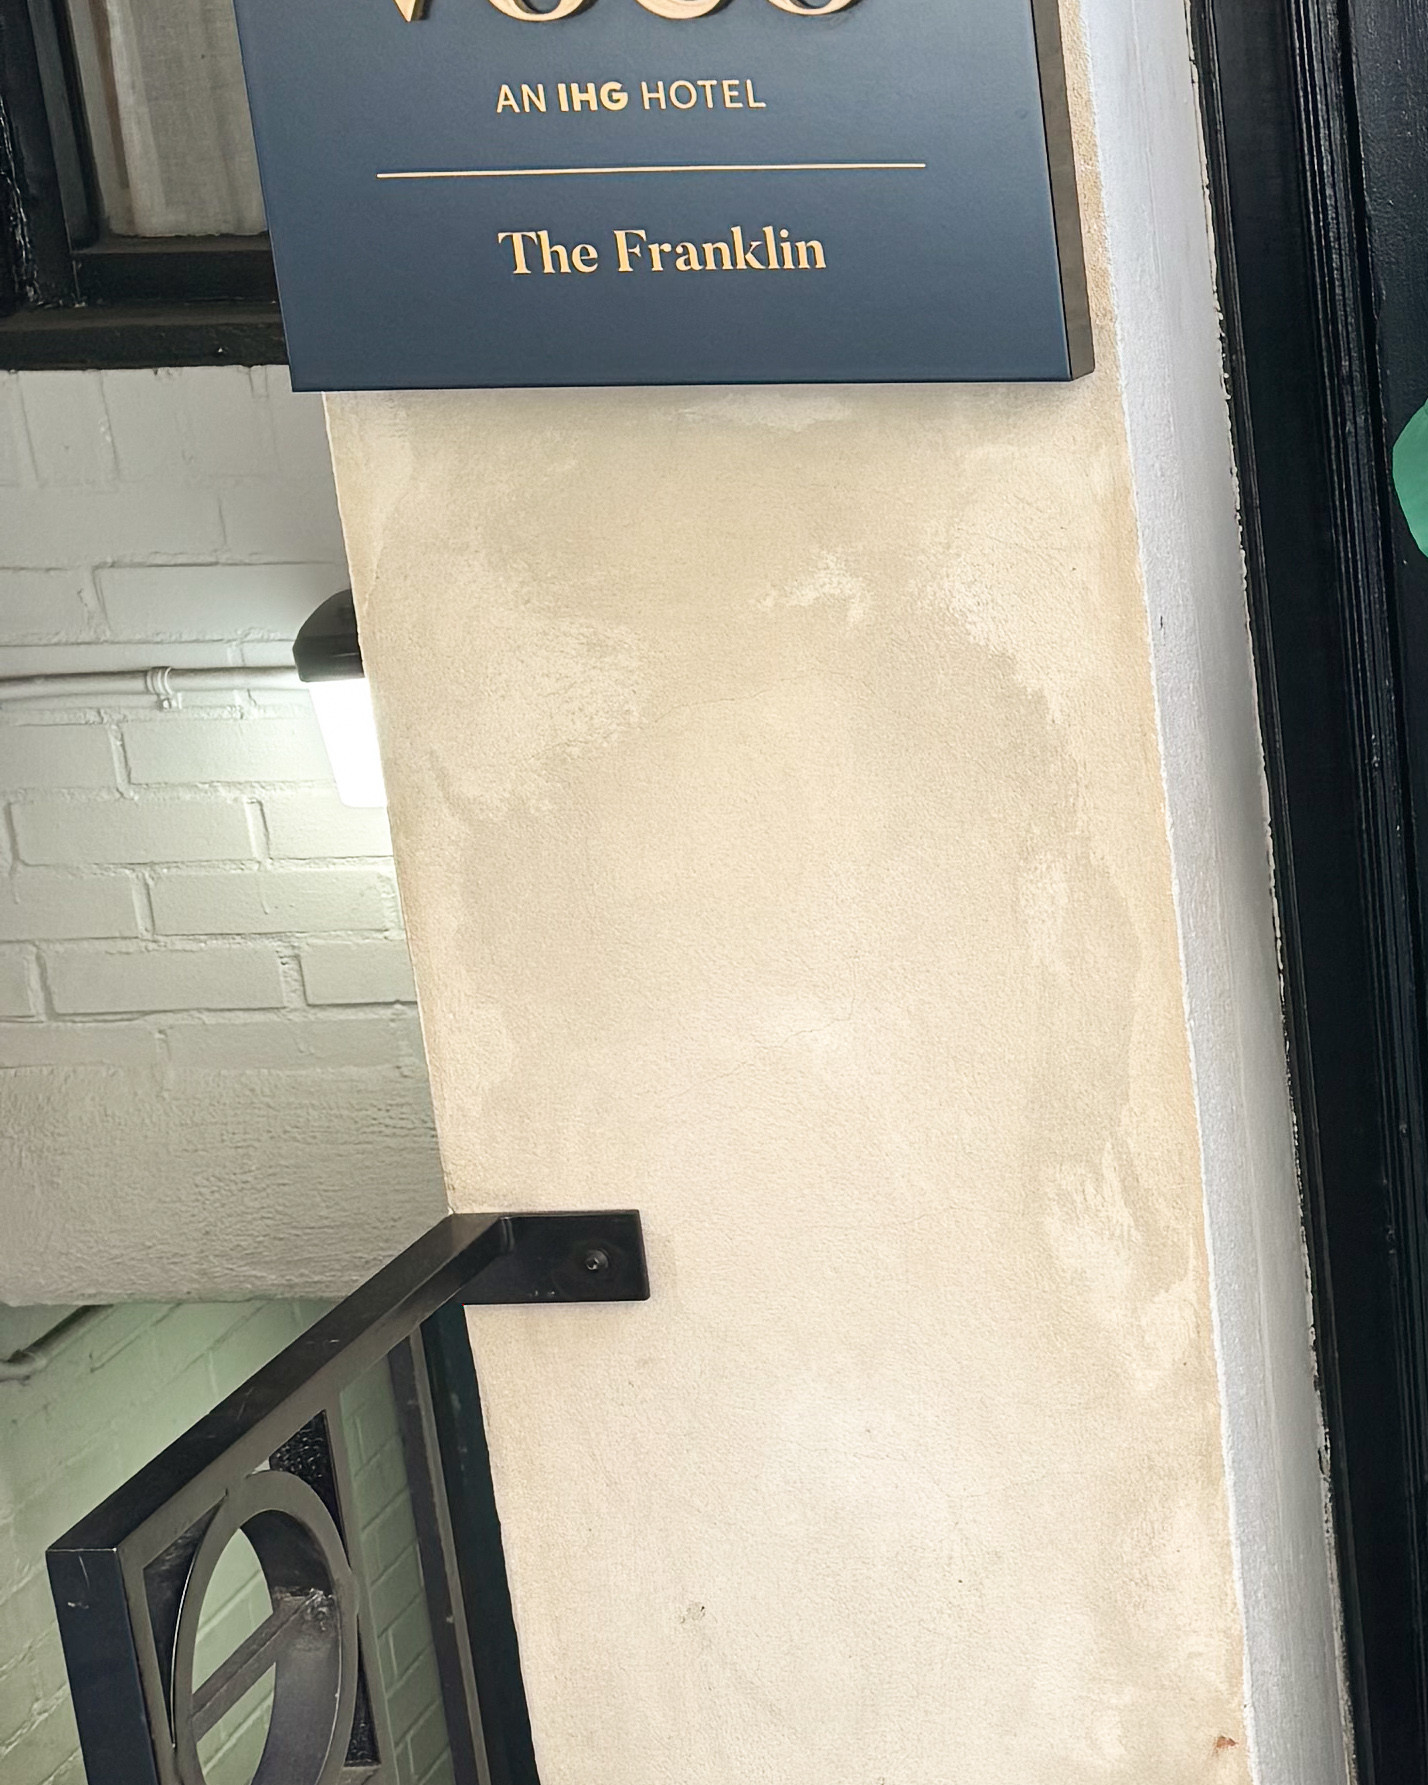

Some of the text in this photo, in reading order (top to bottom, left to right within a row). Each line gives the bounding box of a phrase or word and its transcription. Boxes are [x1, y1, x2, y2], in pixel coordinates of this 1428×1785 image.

[496, 79, 767, 113] AN IHG HOTEL
[497, 225, 827, 275] The Franklin
